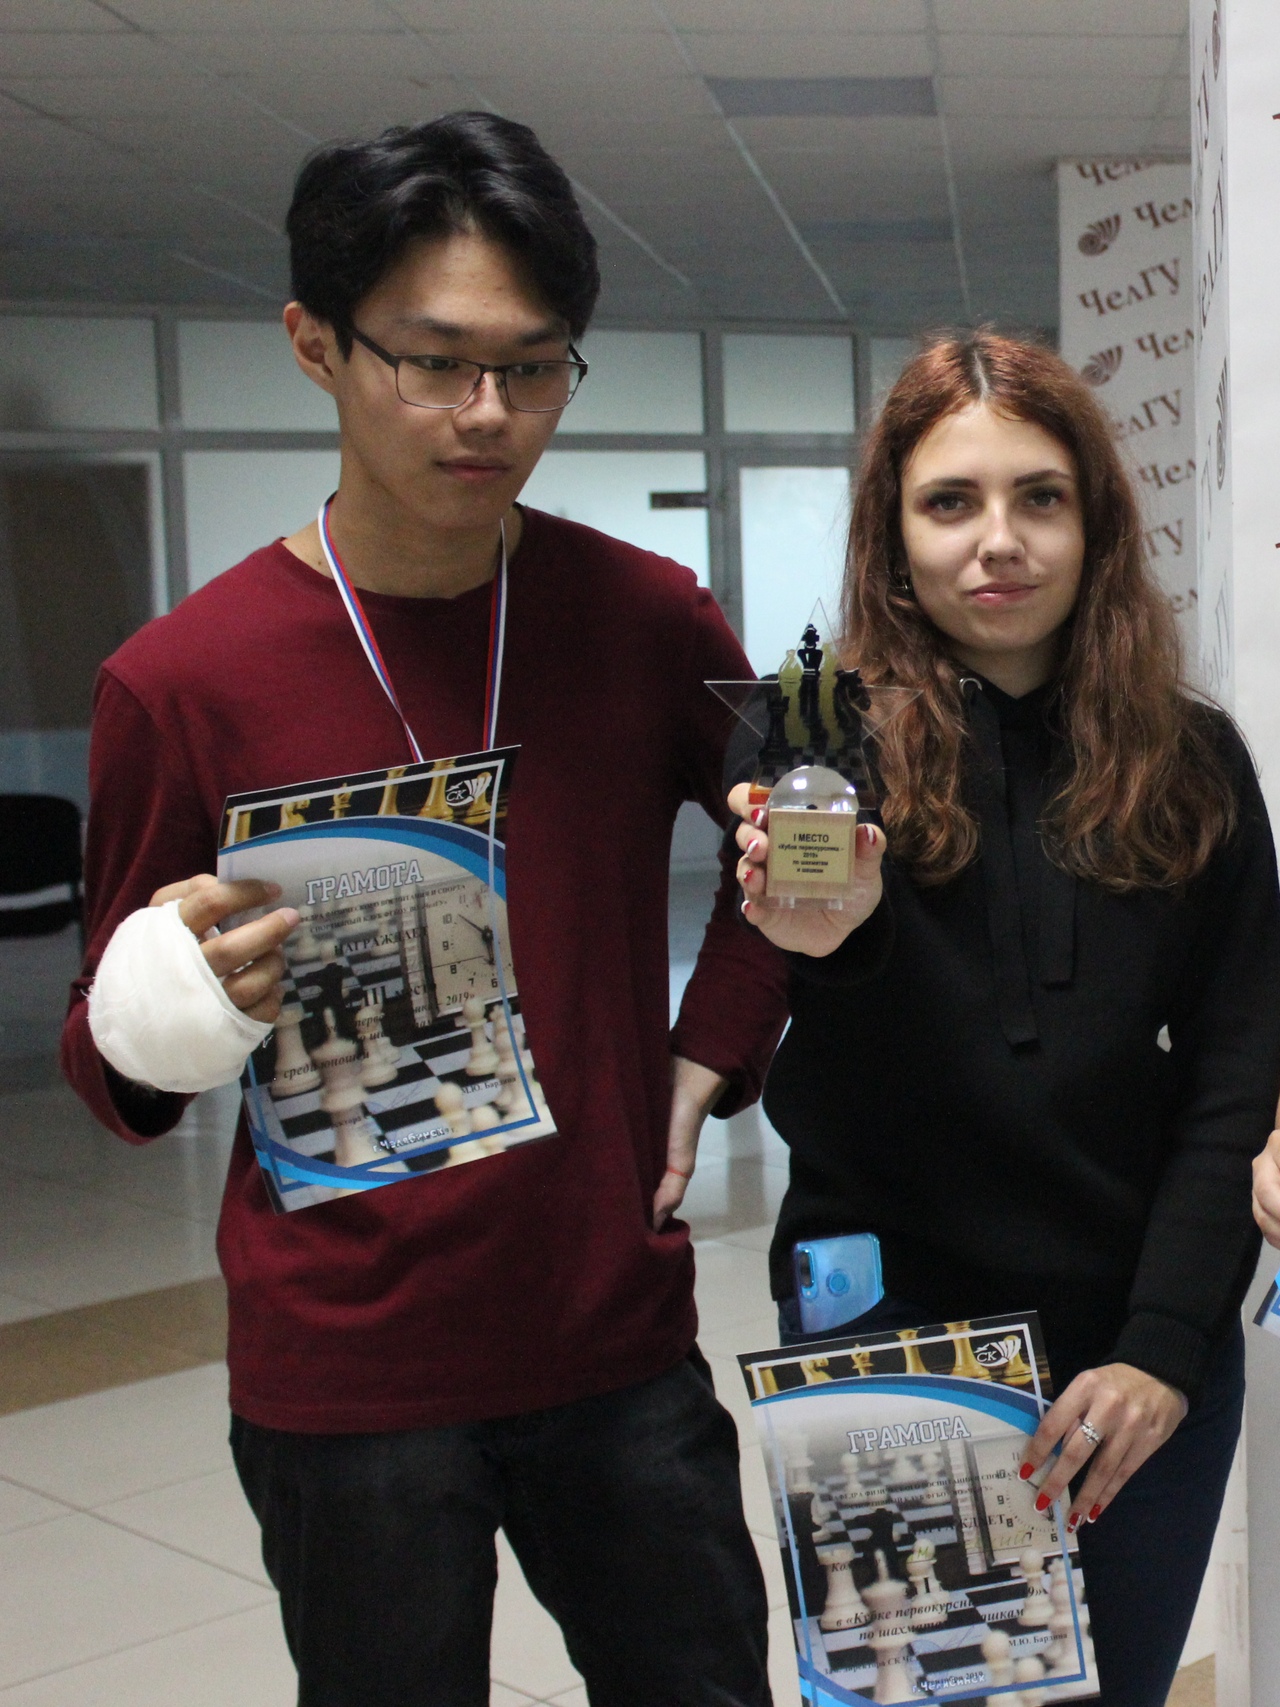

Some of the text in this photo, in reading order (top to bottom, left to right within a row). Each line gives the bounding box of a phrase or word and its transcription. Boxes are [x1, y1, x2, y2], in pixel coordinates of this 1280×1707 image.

[1078, 258, 1181, 316] ЧелГУ
[793, 833, 829, 843] I МЕСТО
[305, 859, 424, 906] ГРАМОТА
[442, 914, 453, 925] 10
[442, 941, 449, 951] 9
[450, 965, 457, 974] 8
[468, 978, 474, 987] 7
[491, 978, 498, 988] 6
[446, 991, 475, 1006] 2019»
[977, 1350, 997, 1362] СК
[846, 1416, 971, 1454] ГРАМОТА
[997, 1495, 1004, 1505] 9
[1006, 1518, 1013, 1527] 8
[1051, 1533, 1058, 1542] 6
[836, 1618, 842, 1627] в
[859, 1630, 874, 1640] по
